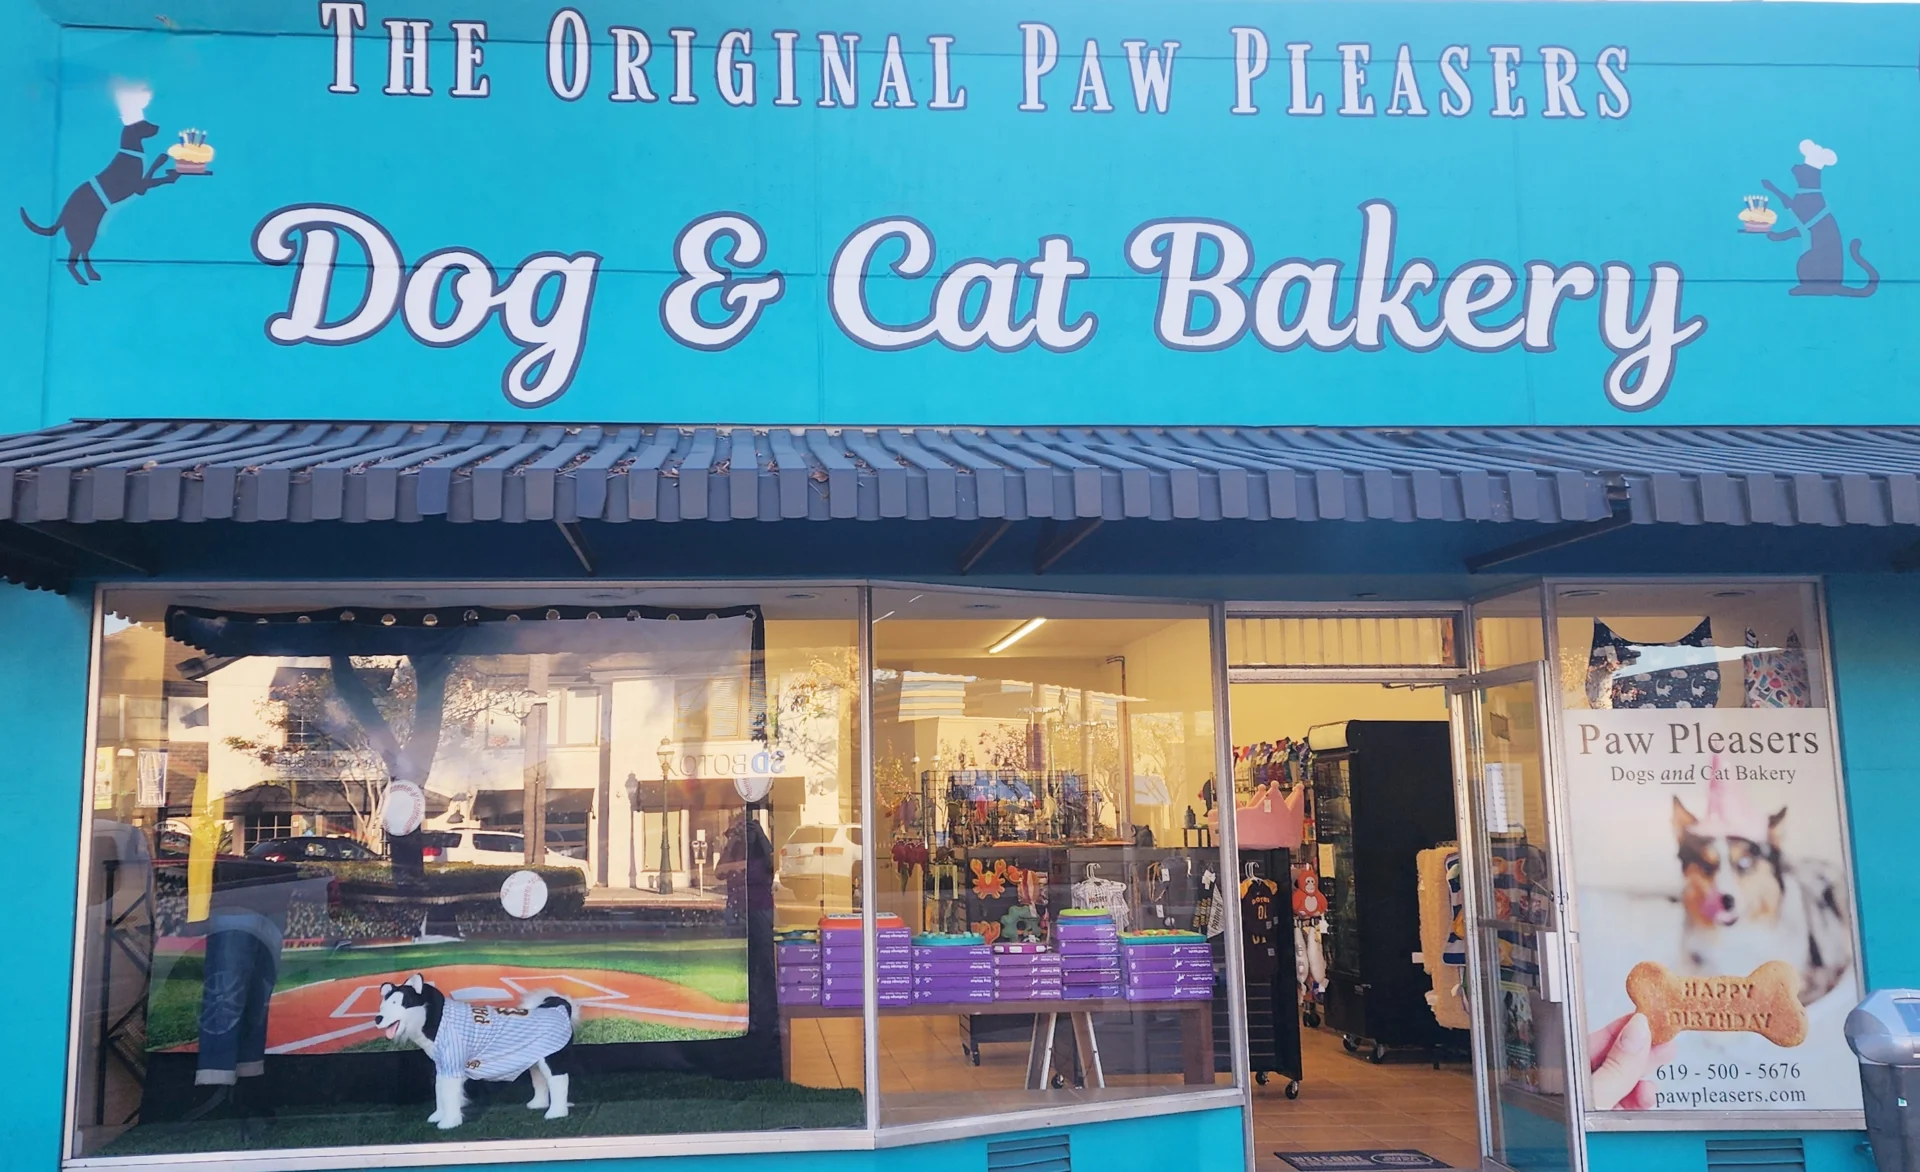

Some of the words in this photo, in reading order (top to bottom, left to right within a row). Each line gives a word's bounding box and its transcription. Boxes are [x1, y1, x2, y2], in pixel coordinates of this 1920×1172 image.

[320, 1, 490, 98] THE
[546, 7, 967, 111] ORIGINAL
[1017, 20, 1181, 115] PAW
[1230, 25, 1632, 119] PLEASERS
[251, 203, 603, 409] Dog
[659, 211, 785, 352] &
[827, 215, 1098, 353] Cat
[1123, 198, 1708, 413] Bakery
[1577, 723, 1655, 755] Paw
[1666, 722, 1820, 754] Pleasers
[1611, 766, 1655, 784] Dogs
[1660, 764, 1696, 784] and
[1700, 766, 1731, 781] Cat
[1735, 765, 1797, 784] Bakery
[1684, 981, 1754, 999] HAPPY
[1667, 1009, 1773, 1029] BIRTHDAY
[1656, 1063, 1688, 1080] 619
[1707, 1062, 1739, 1080] 500
[1757, 1062, 1801, 1079] 5676
[1655, 1087, 1807, 1108] pawpleasers.com
